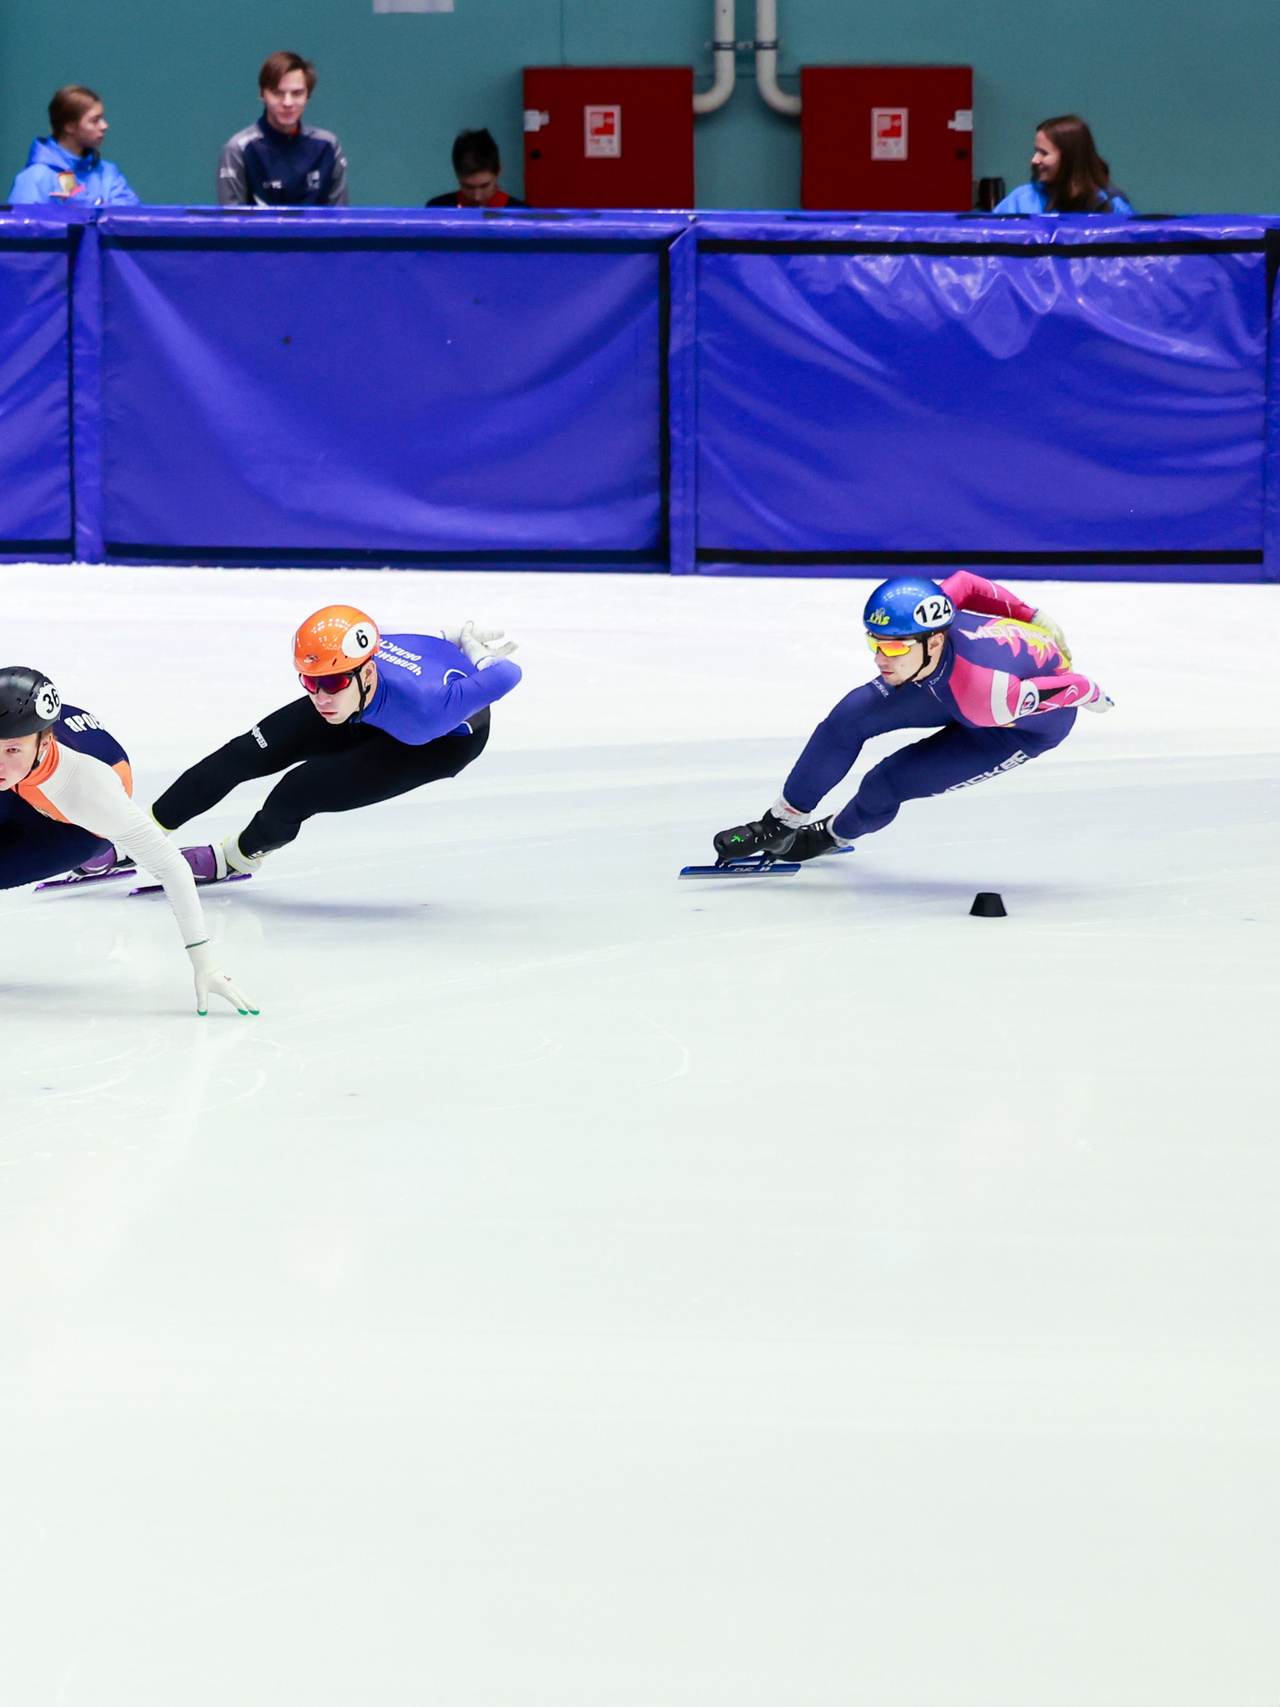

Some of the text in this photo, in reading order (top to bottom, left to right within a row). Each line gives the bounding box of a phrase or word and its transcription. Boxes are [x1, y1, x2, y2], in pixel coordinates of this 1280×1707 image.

[915, 598, 952, 624] 124
[355, 629, 369, 649] 6
[42, 688, 60, 714] 36
